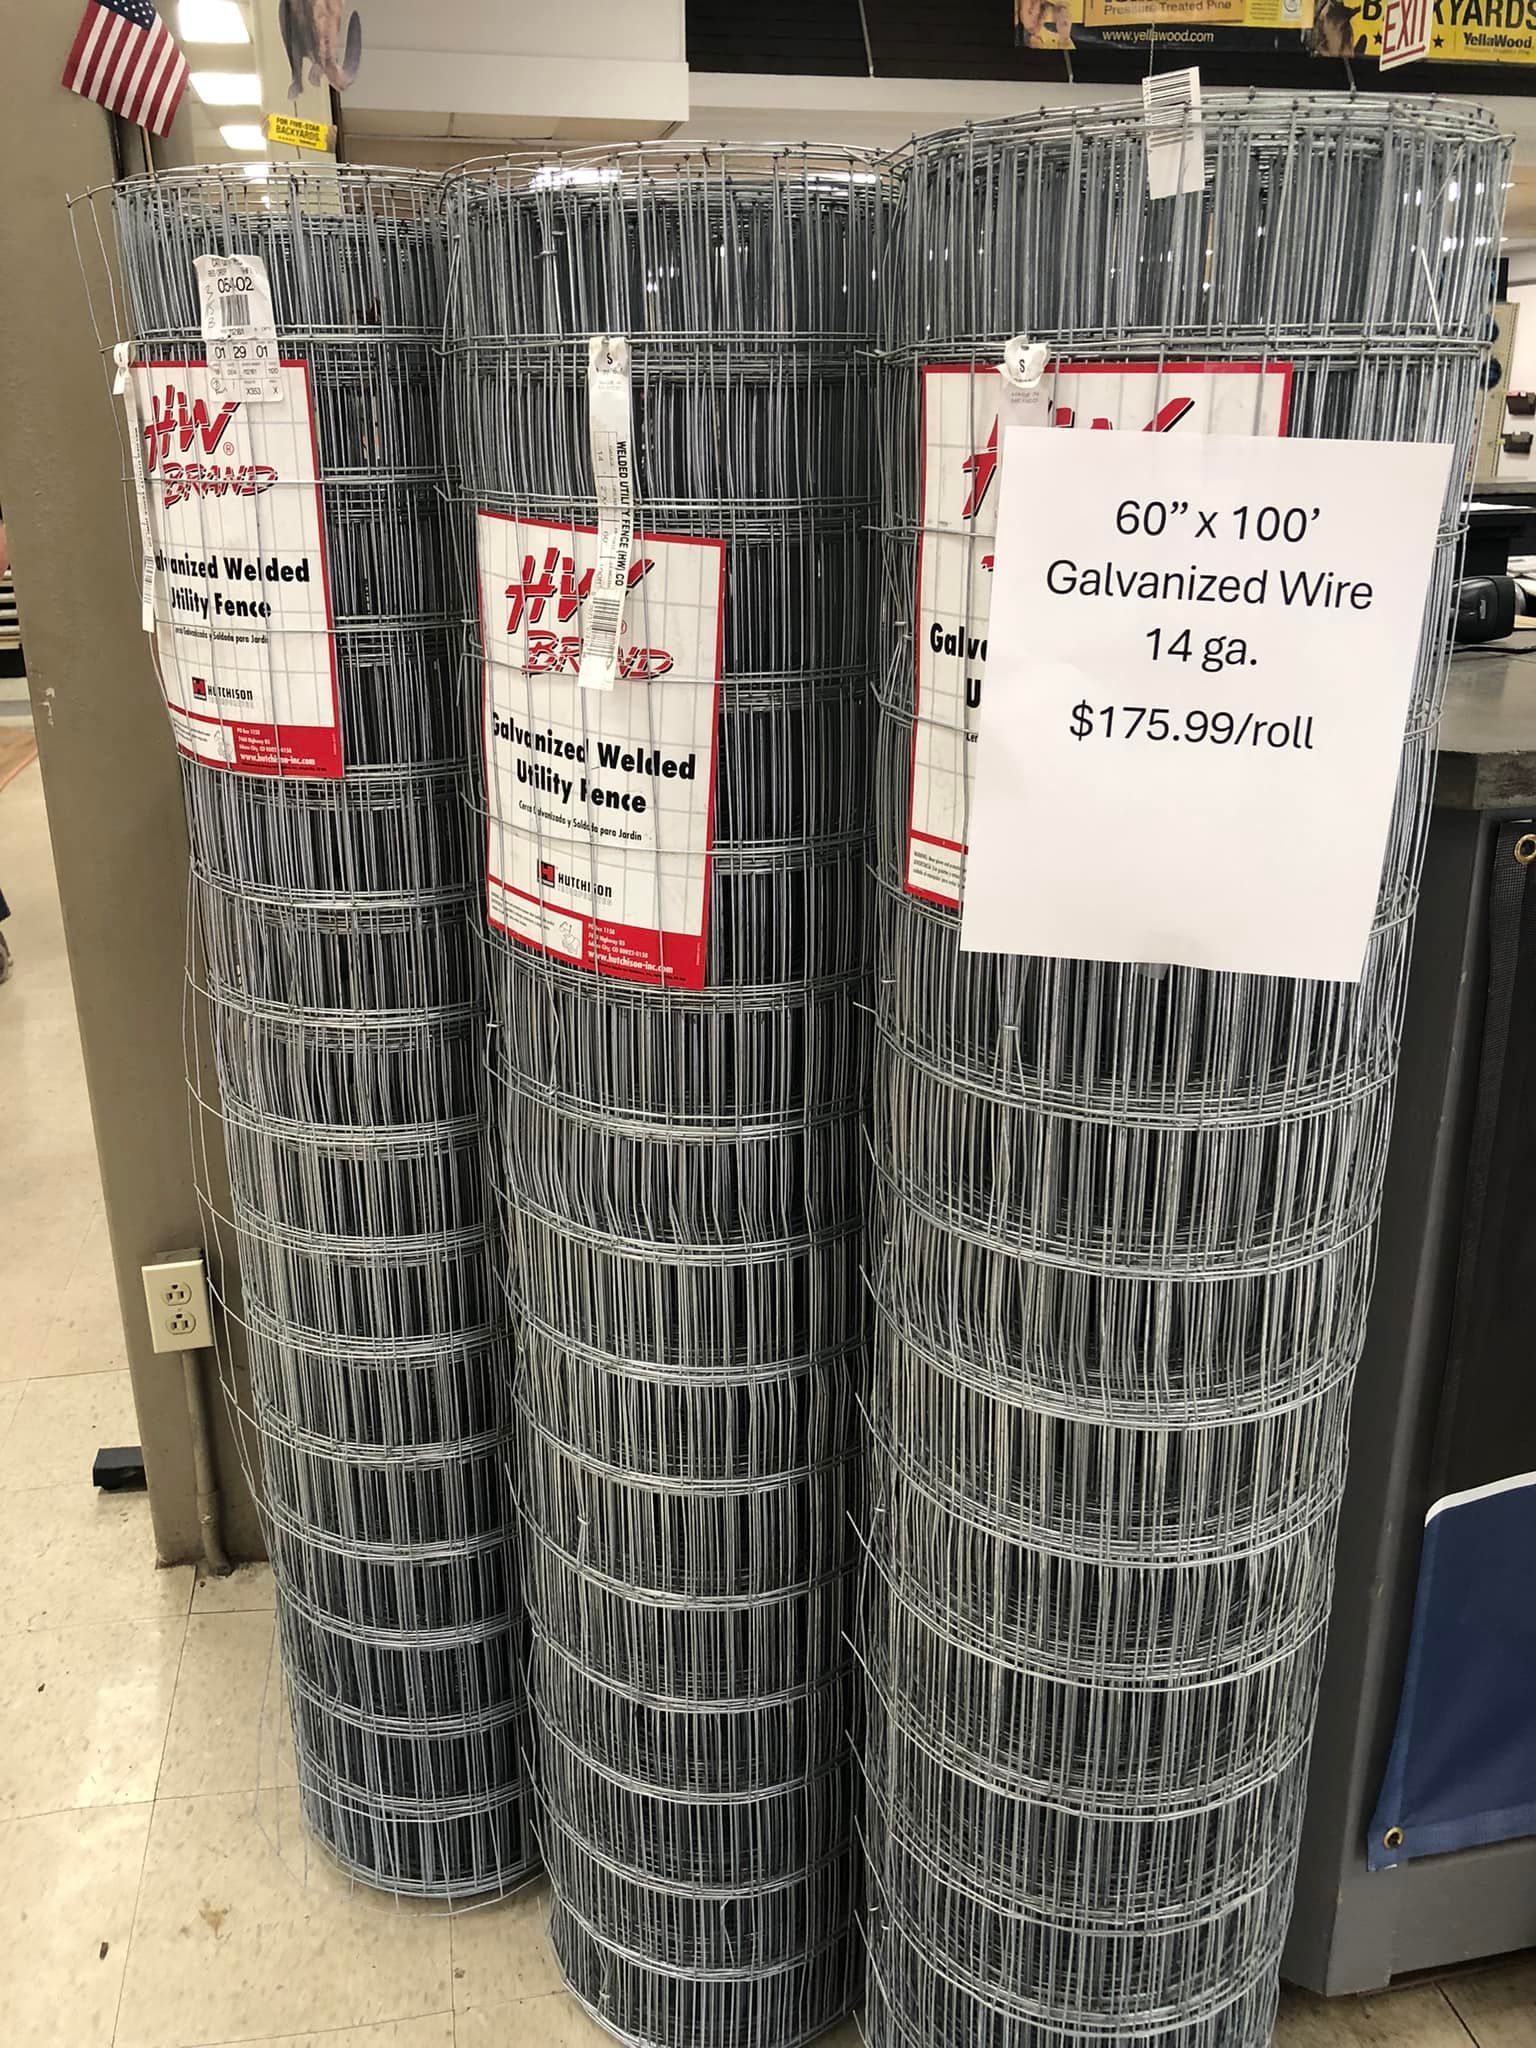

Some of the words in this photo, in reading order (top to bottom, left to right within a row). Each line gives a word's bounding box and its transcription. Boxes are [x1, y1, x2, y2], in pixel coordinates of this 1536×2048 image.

[1160, 1, 1203, 12] Treated
[233, 345, 247, 359] 29
[256, 344, 268, 359] 01
[1019, 358, 1026, 374] S
[617, 440, 629, 479] WELDED
[619, 519, 631, 549] FENCE
[1194, 510, 1219, 539] x
[223, 555, 311, 583] Welded
[614, 572, 625, 587] CO
[1046, 559, 1268, 605] Galvanized
[1279, 569, 1374, 610] Wire
[1145, 627, 1193, 663] 14
[1200, 635, 1258, 673] ga.
[1069, 698, 1314, 750] $175.99/roll
[596, 741, 697, 780] Welded
[516, 757, 574, 805] Utility
